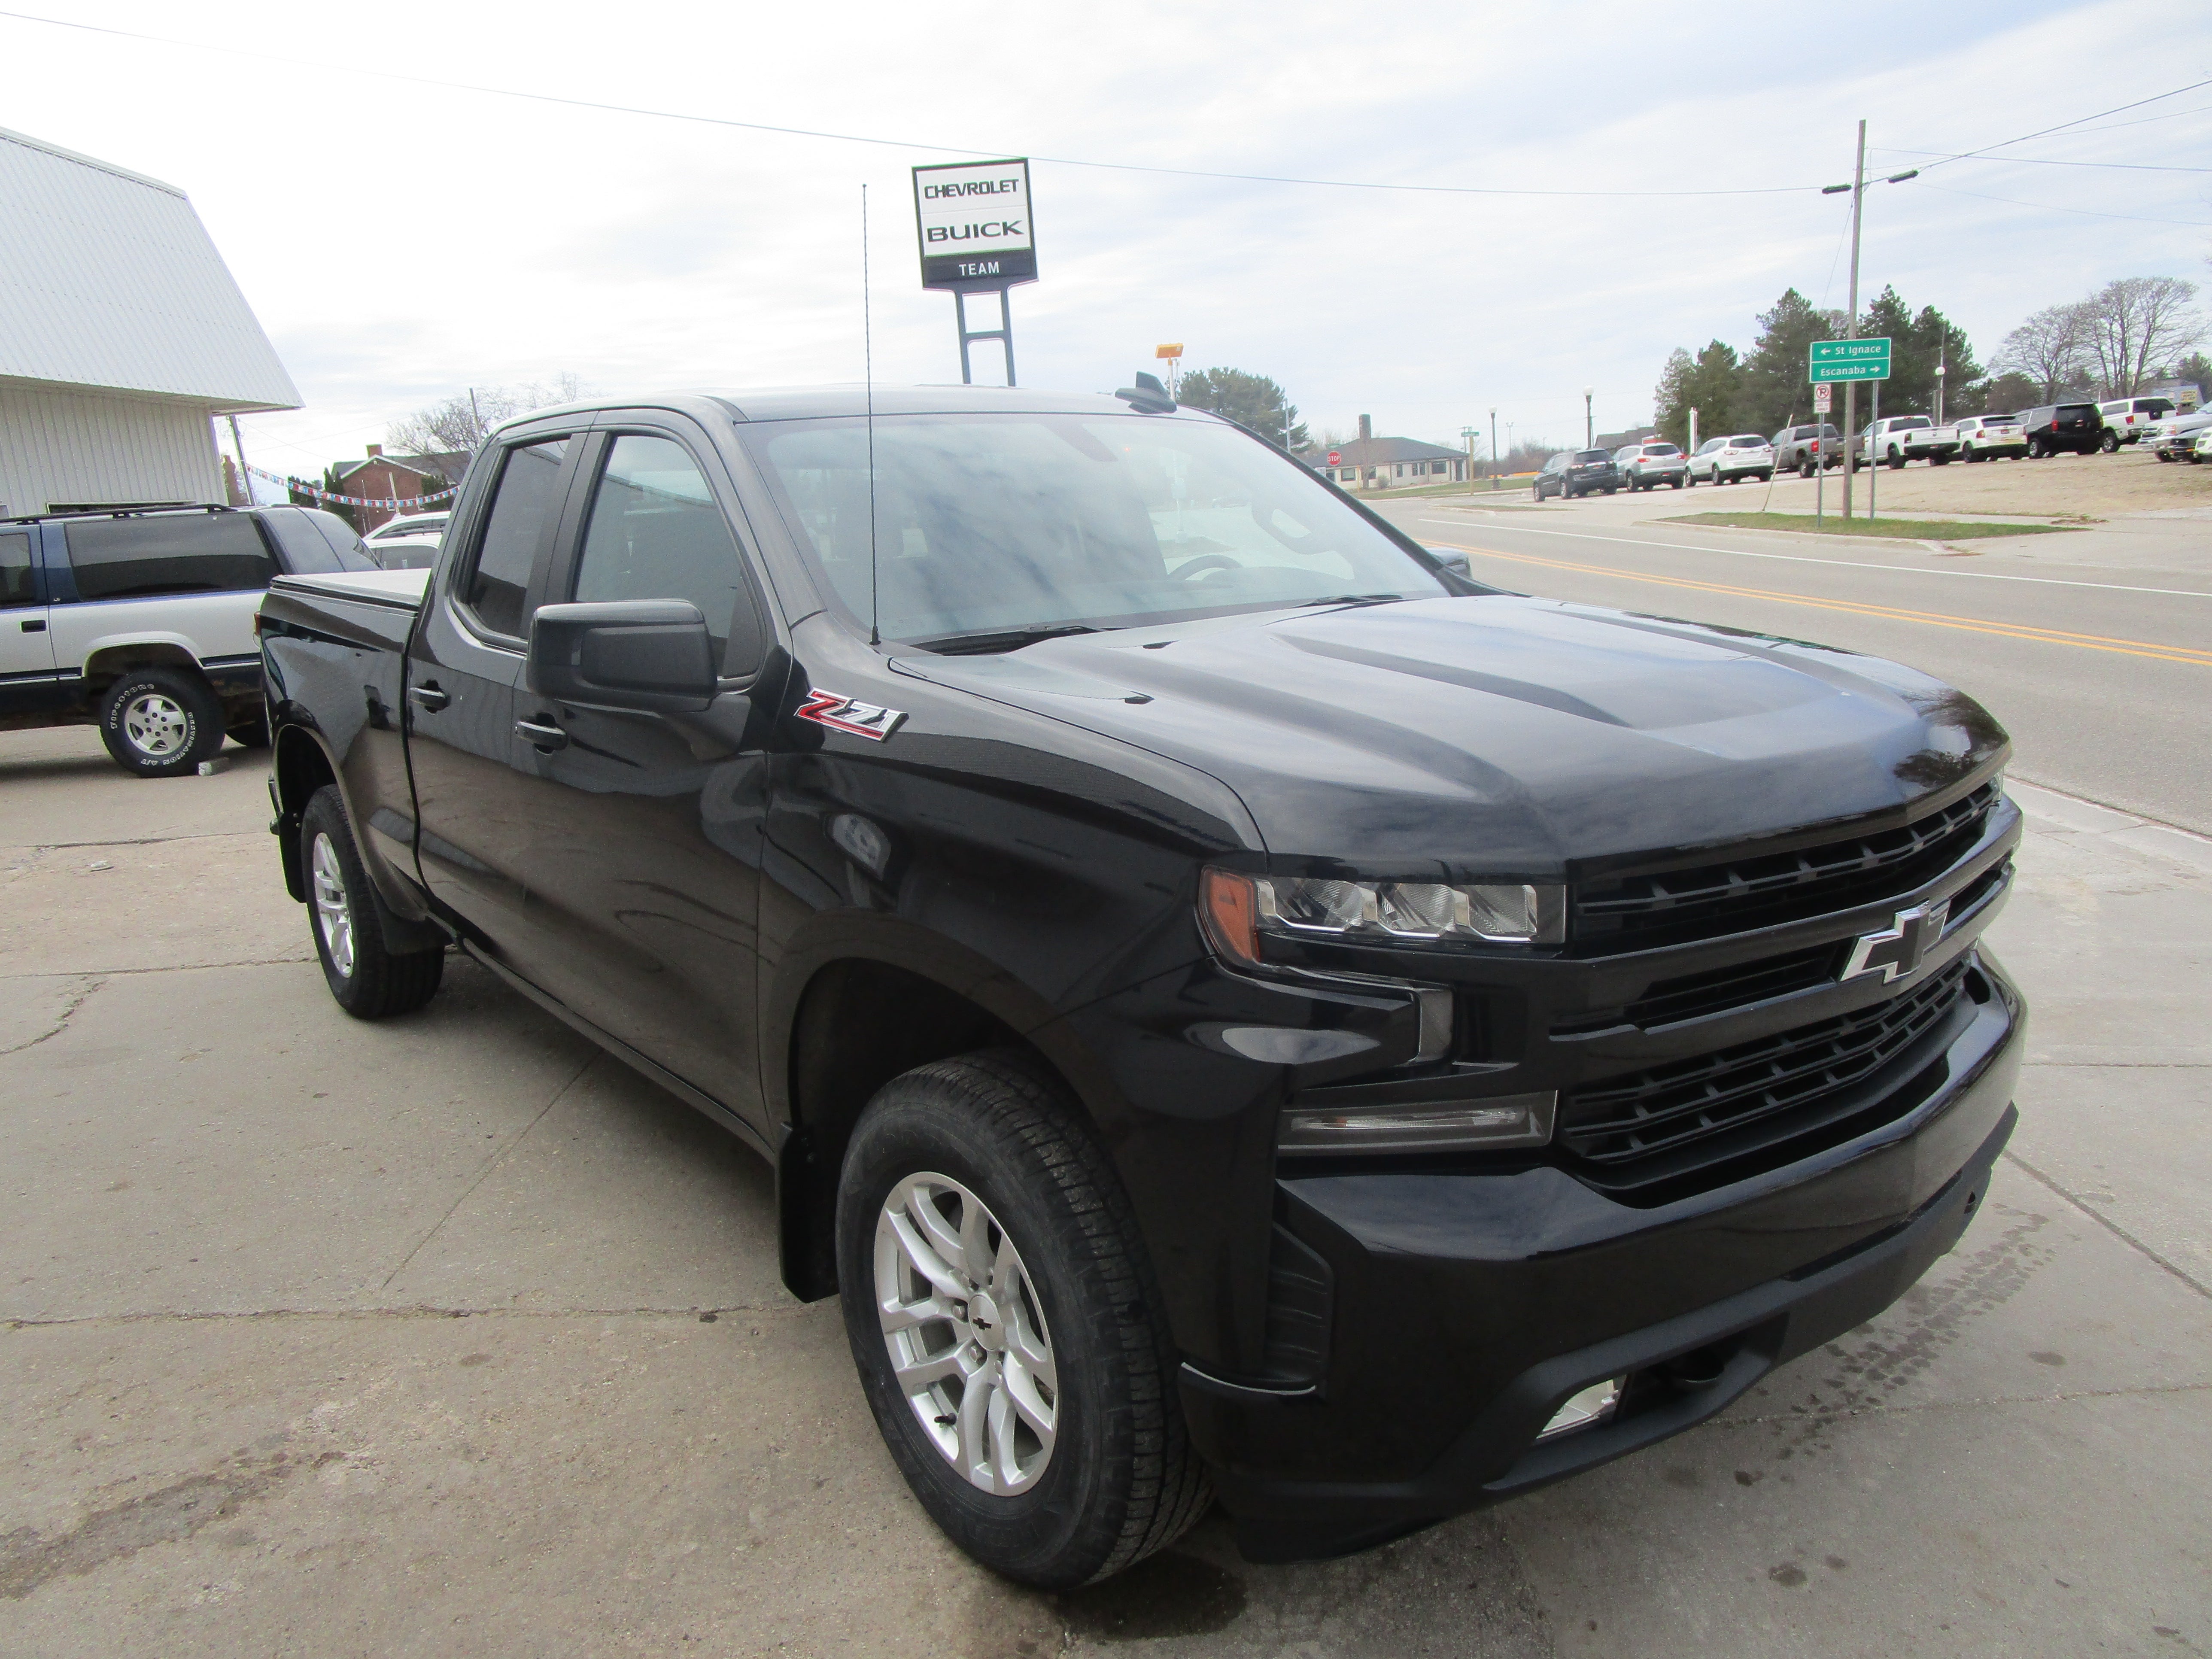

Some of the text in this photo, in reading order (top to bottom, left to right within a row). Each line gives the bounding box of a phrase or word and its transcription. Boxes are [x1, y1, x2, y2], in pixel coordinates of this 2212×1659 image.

[924, 179, 1019, 199] CHEVROLET
[927, 220, 1024, 242] BUICK
[959, 261, 1000, 276] TEAM
[1835, 346, 1881, 356] St Ignace
[1821, 366, 1866, 376] Escanaba
[793, 687, 910, 744] Z71
[162, 712, 196, 766] DESTINATION
